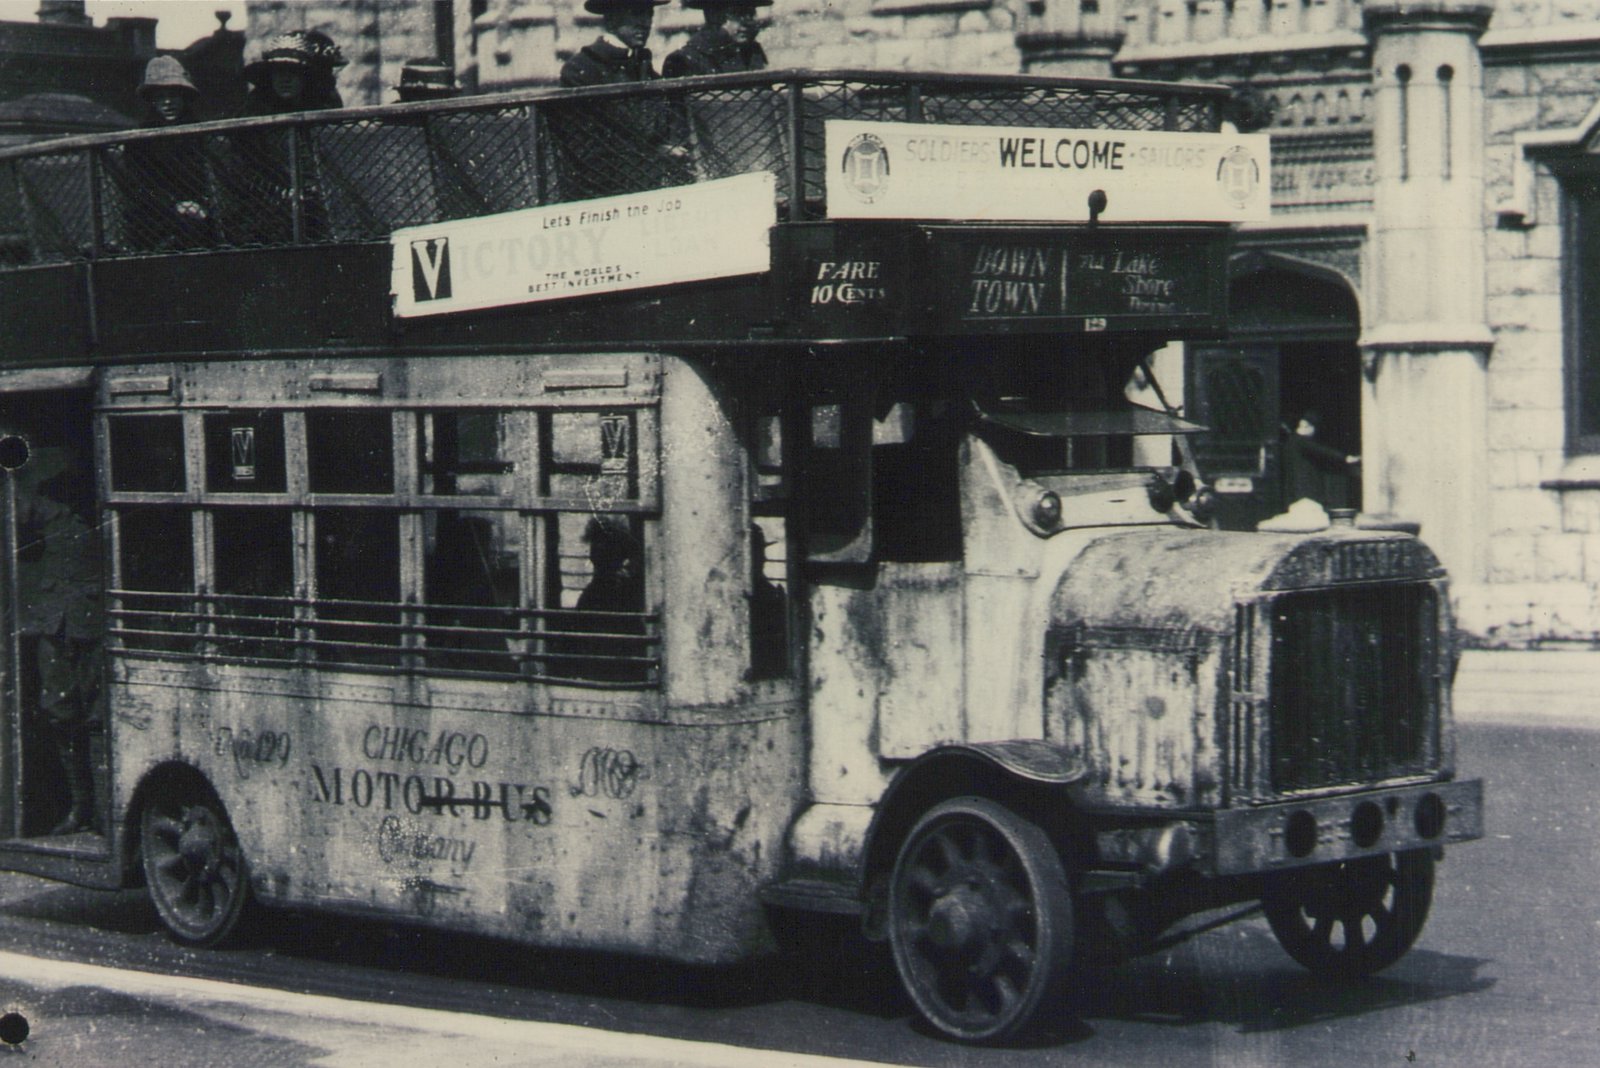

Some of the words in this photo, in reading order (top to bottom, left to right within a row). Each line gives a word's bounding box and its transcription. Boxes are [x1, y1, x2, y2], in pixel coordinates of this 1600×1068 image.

[904, 137, 991, 164] SOLDIERS
[999, 137, 1126, 170] WELCOME
[1138, 145, 1207, 169] SAILORS
[579, 208, 621, 226] Finish
[627, 203, 650, 218] the
[657, 197, 683, 213] Job
[411, 226, 610, 301] VICTORY
[545, 271, 567, 280] THE
[817, 261, 880, 281] FARE
[971, 245, 1051, 278] DOWN
[1111, 250, 1160, 275] Lake
[527, 281, 557, 293] BEST
[562, 271, 641, 289] INVESTMENT
[810, 284, 834, 304] 10
[969, 279, 1046, 313] TOWN
[1121, 274, 1174, 297] Shore
[363, 725, 489, 776] CHICAGO
[312, 765, 461, 818] MOTOR
[471, 781, 553, 826] BUS
[378, 815, 477, 868] Cpany
